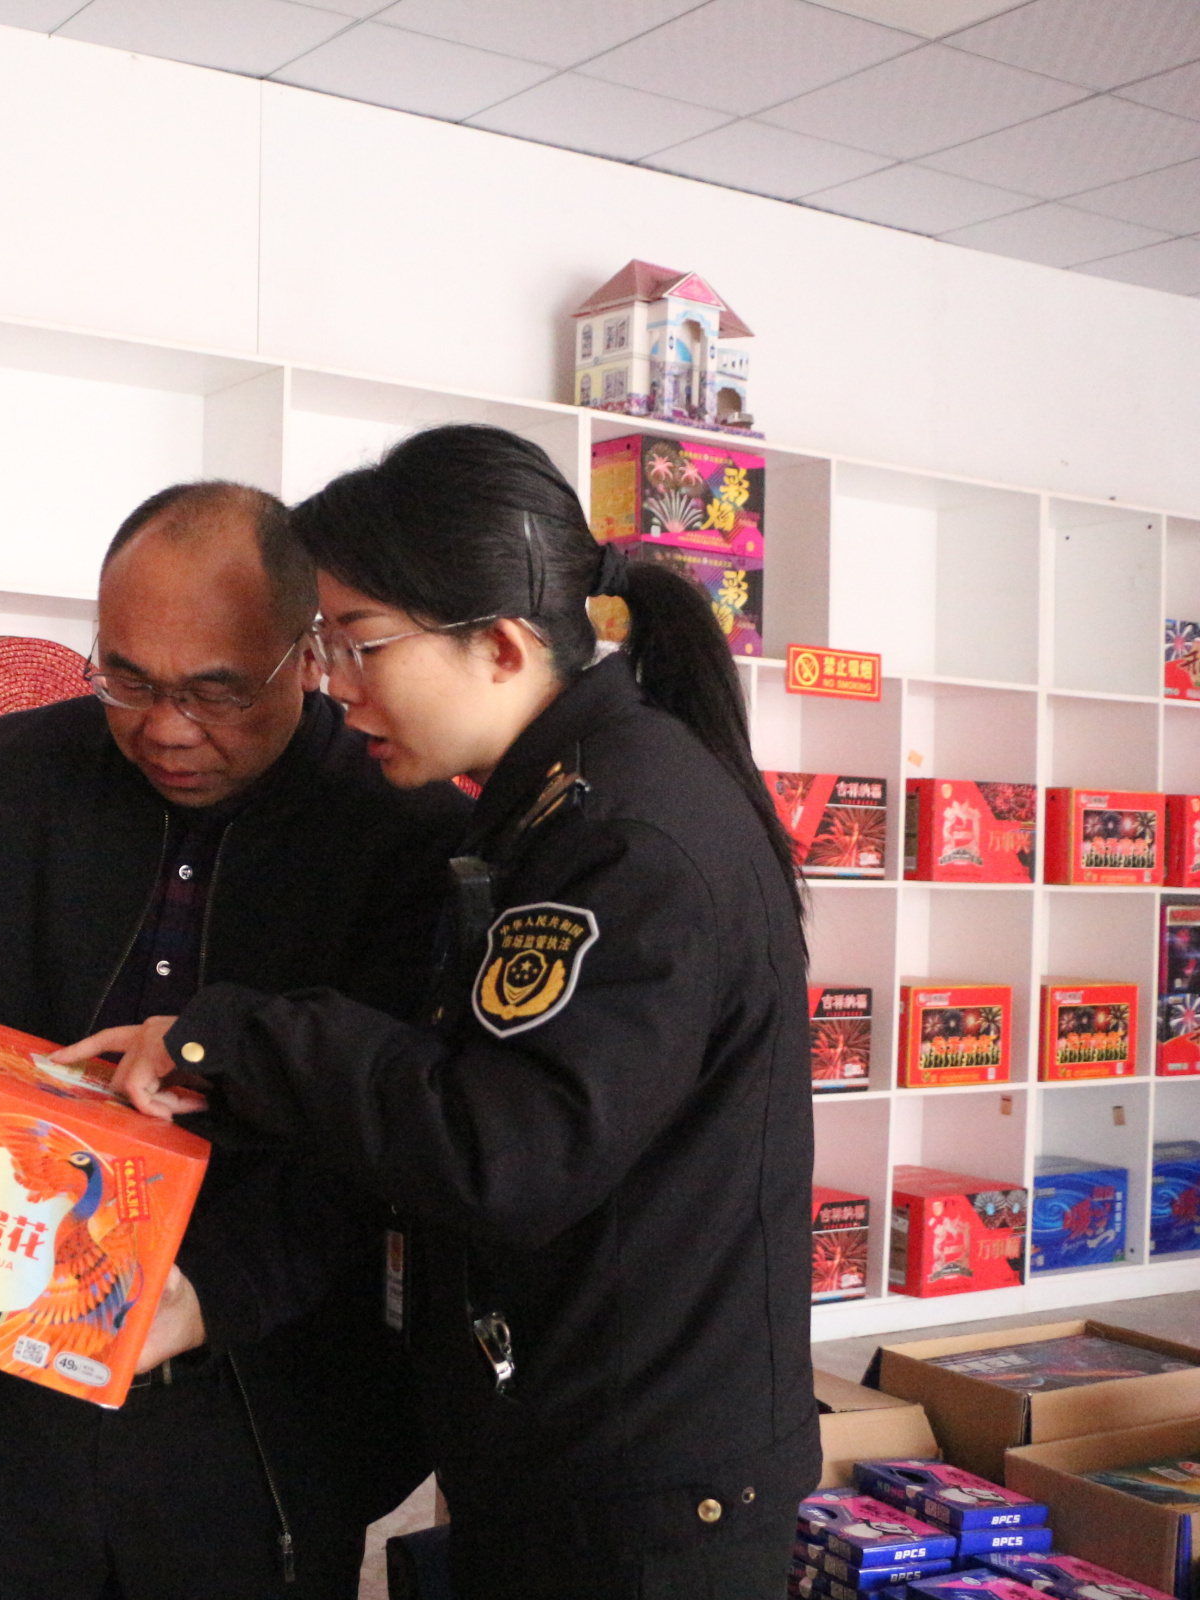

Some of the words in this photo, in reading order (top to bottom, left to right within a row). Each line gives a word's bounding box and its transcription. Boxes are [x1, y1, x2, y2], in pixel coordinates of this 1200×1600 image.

[823, 656, 873, 680] 禁止吸烟
[823, 679, 835, 688] NO
[837, 680, 872, 692] SMOKING
[500, 915, 584, 938] 中华人民共和国
